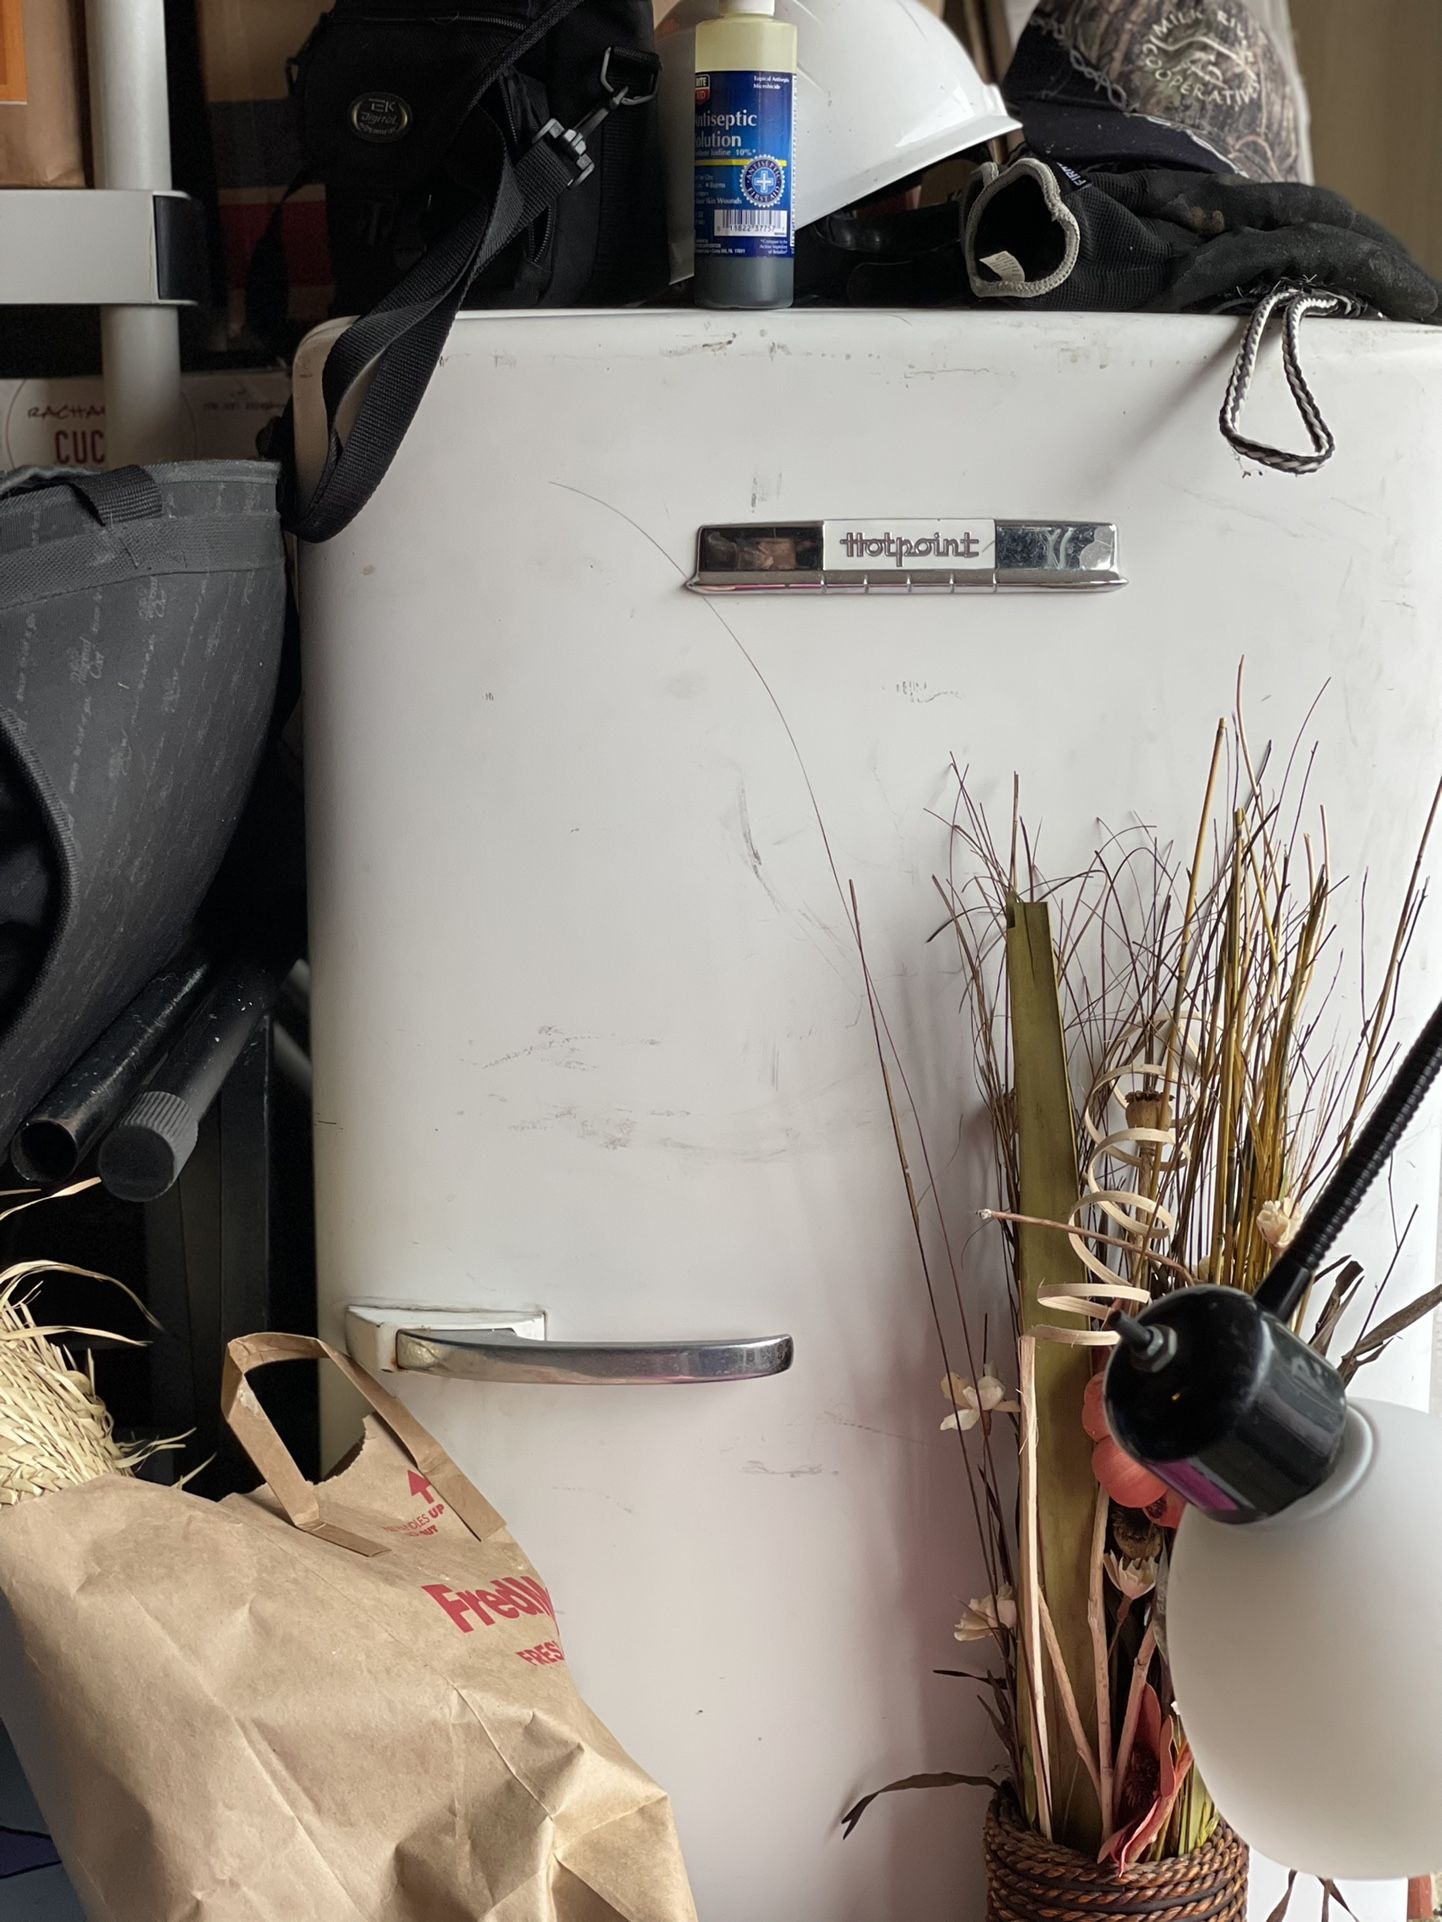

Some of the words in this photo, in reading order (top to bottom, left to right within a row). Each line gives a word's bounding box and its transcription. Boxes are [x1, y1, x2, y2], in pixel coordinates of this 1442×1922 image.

[695, 130, 742, 148] olution
[746, 160, 781, 180] ANTISEPTIC
[746, 188, 768, 202] FIRST
[770, 186, 780, 199] AID
[55, 429, 105, 465] CUC
[840, 532, 980, 567] Hotpoint
[428, 1503, 445, 1518] UP
[421, 1575, 560, 1634] FredM
[515, 1640, 565, 1667] FRES
